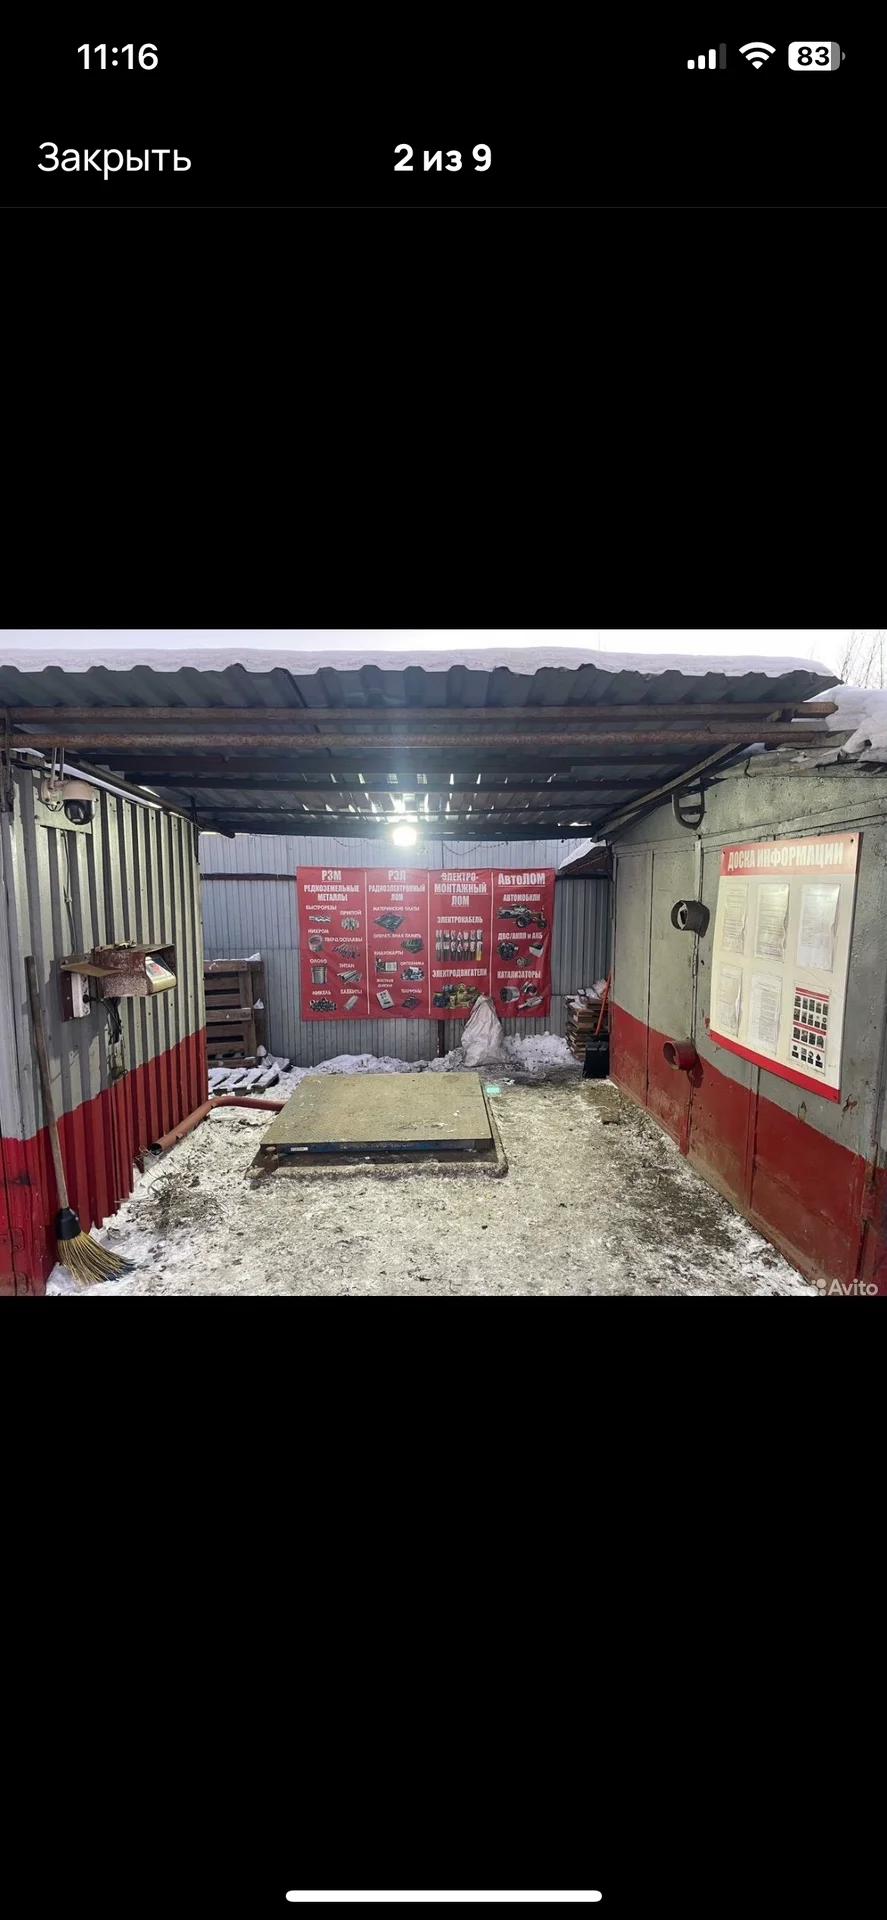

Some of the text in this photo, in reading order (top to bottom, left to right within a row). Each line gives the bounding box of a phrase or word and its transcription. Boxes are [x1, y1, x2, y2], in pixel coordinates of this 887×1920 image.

[728, 842, 844, 870] ДОСКА ИНФОРМАЦИИ
[321, 870, 342, 881] РЗМ
[498, 873, 546, 885] АвтоЛОМ
[304, 885, 360, 893] РЕДКОЗЕМЕЛЬНЫЕ
[368, 884, 426, 893] РАДИОЭЛЕКТРОННЫЙ
[434, 882, 487, 893] МОНТАЖНЫЙ
[317, 893, 348, 902] МЕТАЛЛЫ
[390, 893, 404, 901] ЛОМ
[451, 895, 469, 906] ЛОМ
[503, 893, 541, 902] АВТОМОБИЛИ
[437, 916, 483, 924] ЭЛЕКТРОКАБЕЛЬ
[432, 968, 487, 978] ЭЛЕКТРОДВИГАТЕЛИ
[497, 970, 541, 979] КАТАЛИЗАТОРЫ
